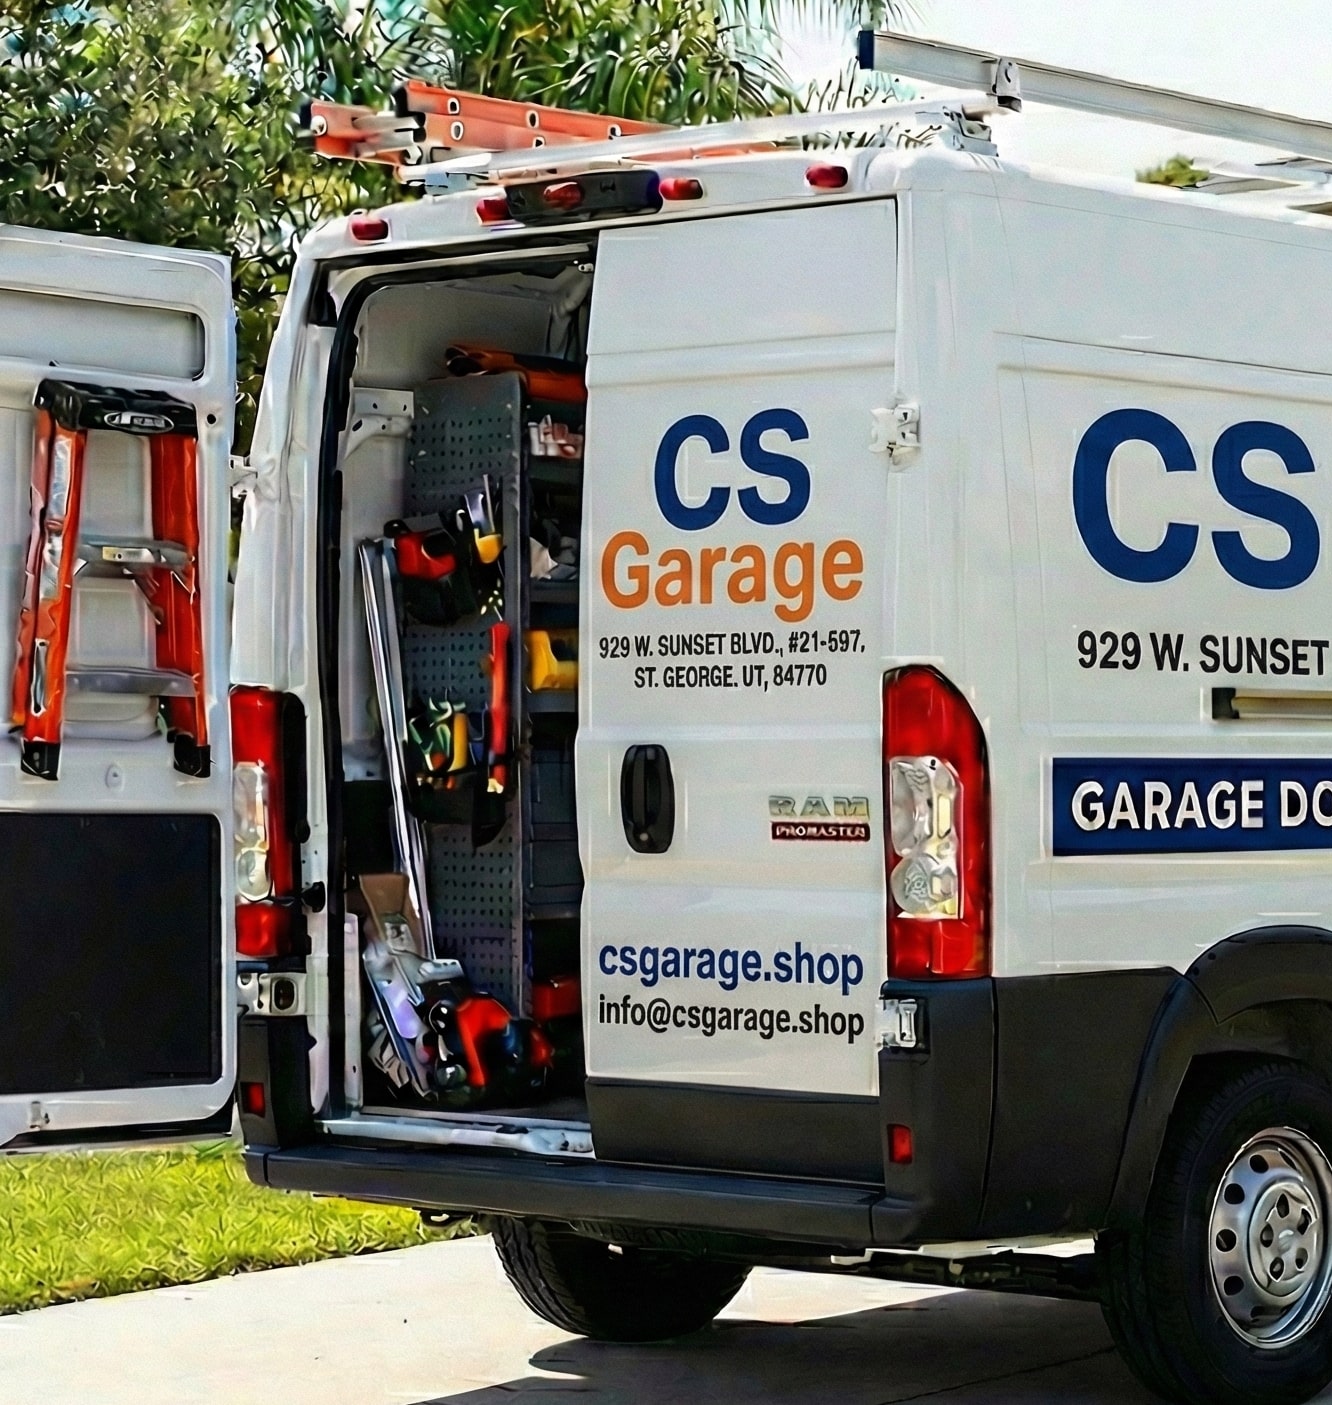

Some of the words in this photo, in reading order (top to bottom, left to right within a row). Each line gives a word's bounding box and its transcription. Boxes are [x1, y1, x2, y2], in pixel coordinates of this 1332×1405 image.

[655, 408, 811, 531] CS
[1072, 408, 1321, 590] CS
[601, 531, 863, 623] Garage
[599, 636, 630, 659] 929
[634, 635, 653, 657] W.
[658, 633, 726, 656] SUNSET
[730, 632, 784, 658] BLVD.,
[788, 630, 866, 654] #21-597,
[1077, 630, 1142, 671] 929
[1149, 632, 1190, 673] W.
[1199, 635, 1330, 676] SUNSET
[634, 666, 659, 688] ST.
[742, 665, 769, 692] UT,
[773, 664, 828, 687] 84770
[768, 795, 870, 818] RAM
[1071, 779, 1264, 832] GARAGE
[599, 942, 864, 997] csgarage.shop
[599, 994, 865, 1044] info@csgarage.shop
